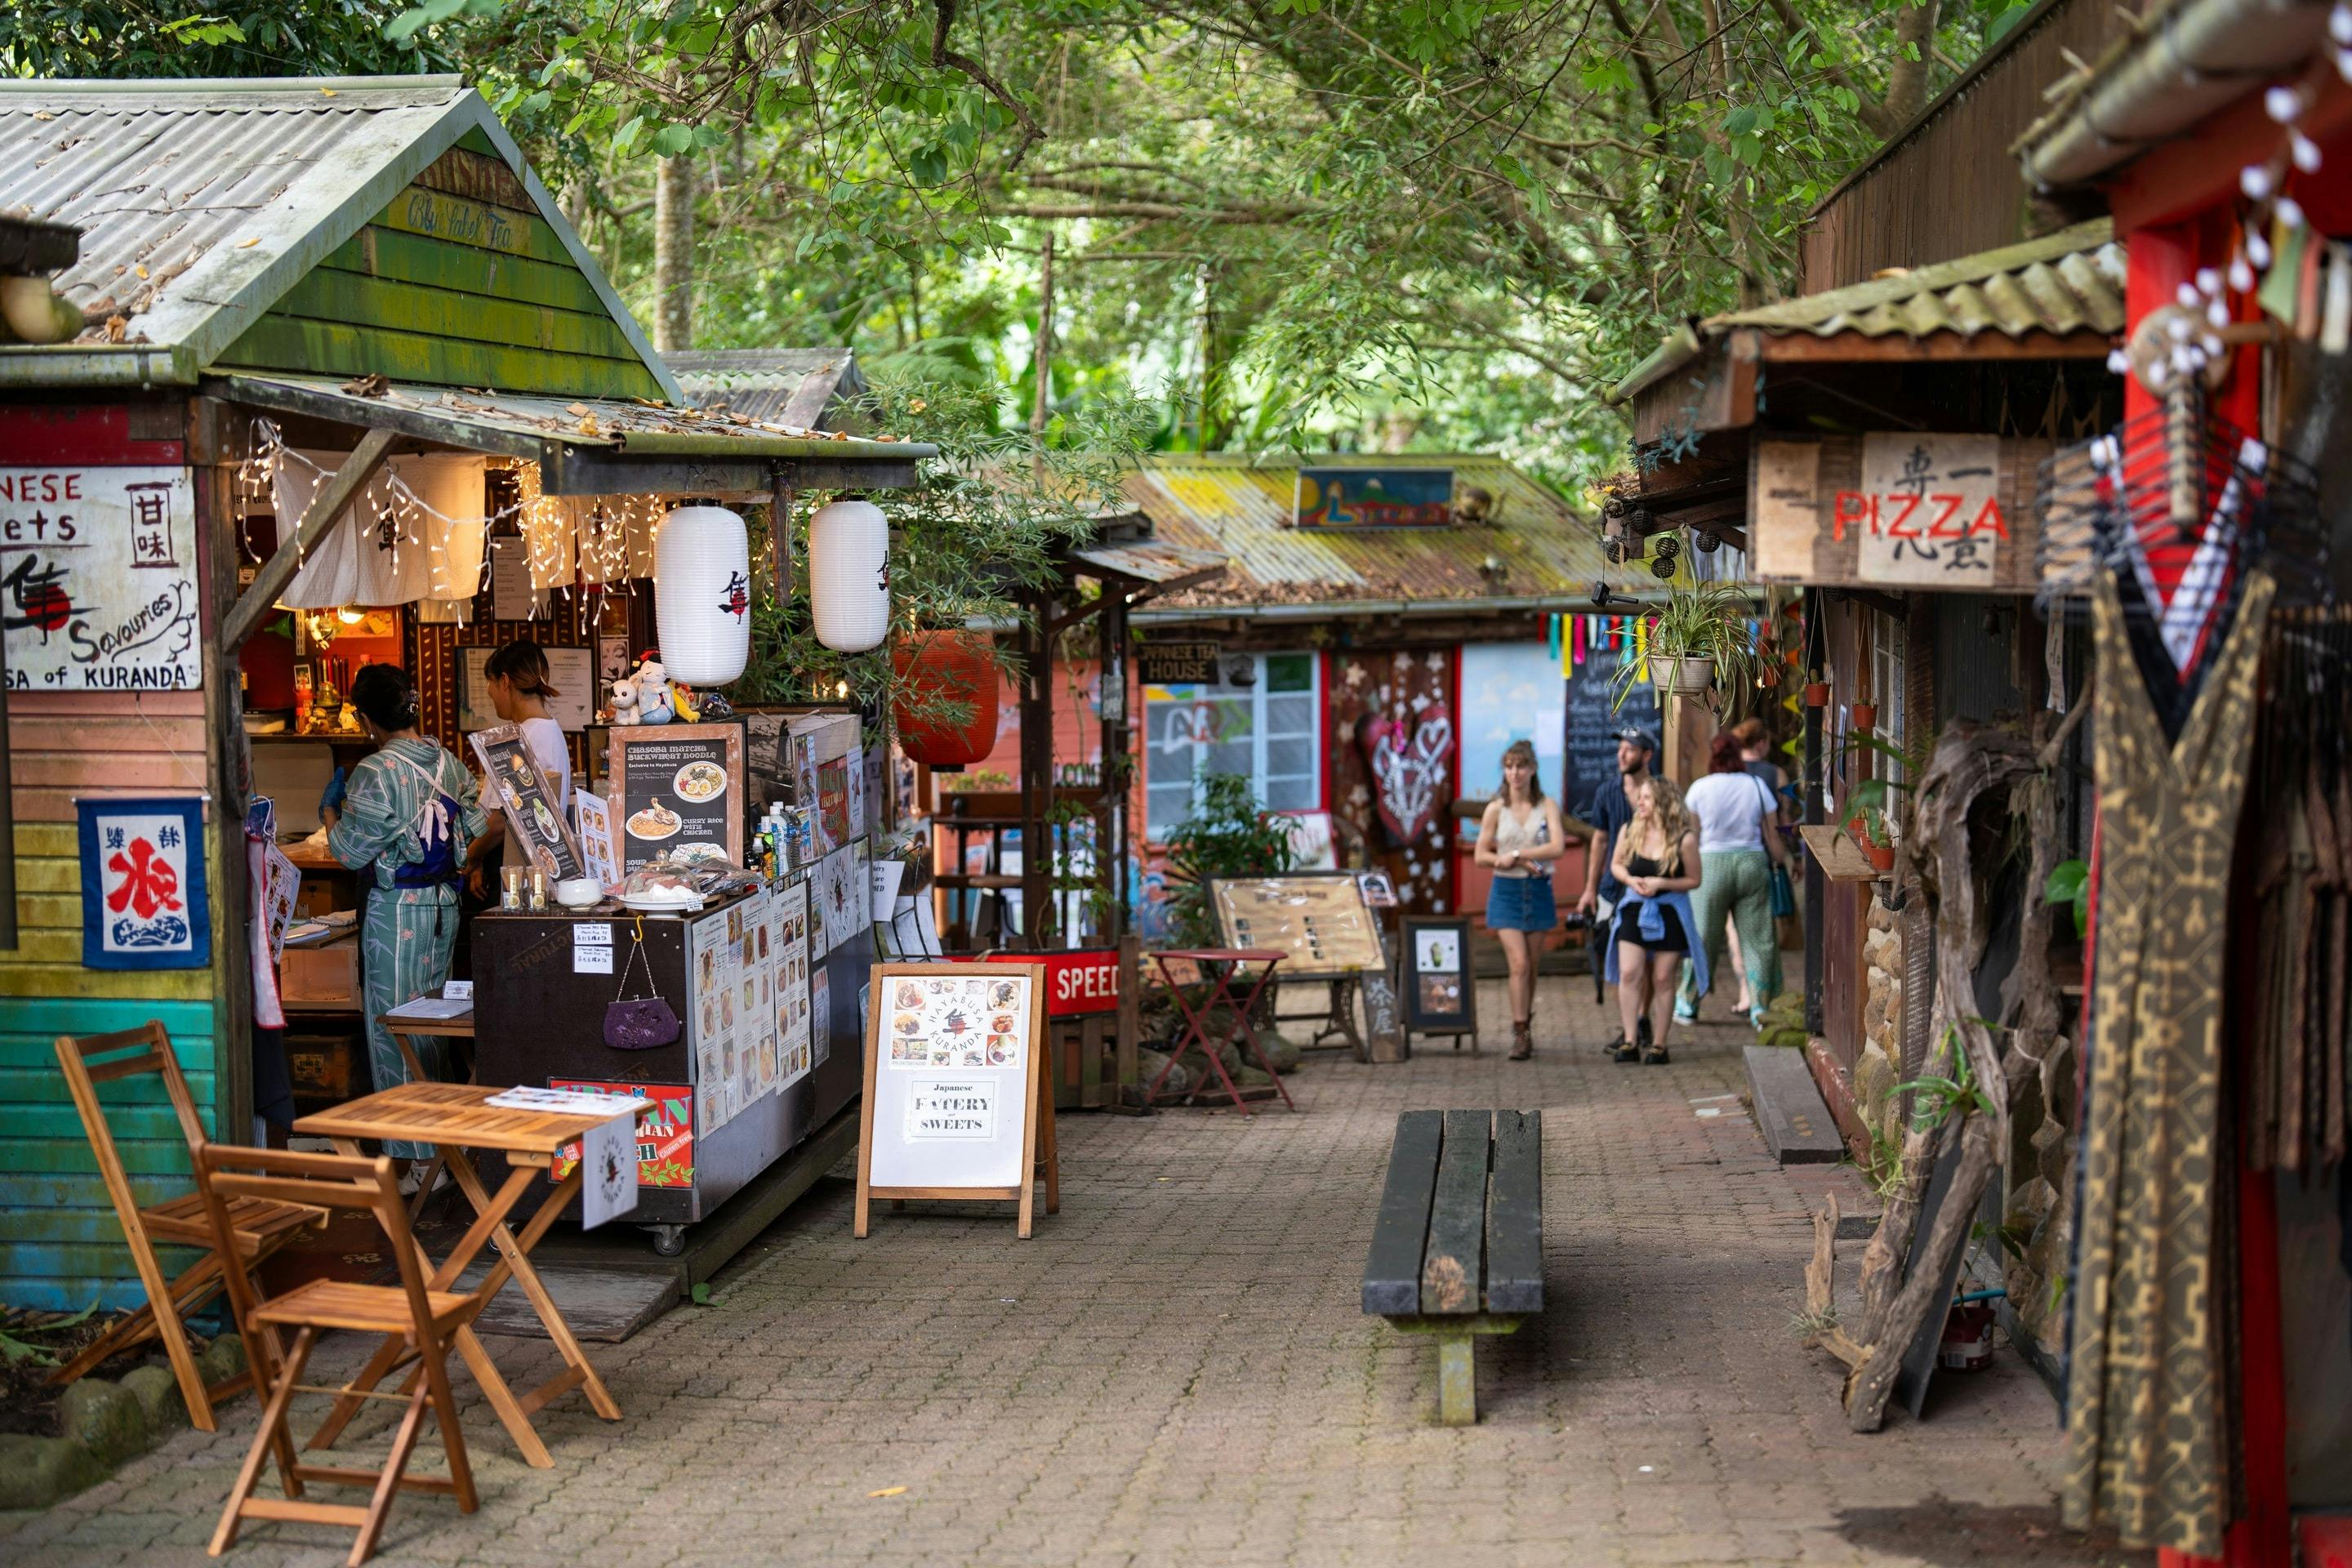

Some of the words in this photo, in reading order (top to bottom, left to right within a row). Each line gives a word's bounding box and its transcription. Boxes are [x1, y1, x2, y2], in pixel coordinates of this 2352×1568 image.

[135, 494, 167, 559] 甘味
[1833, 491, 2009, 541] PIZZA
[69, 593, 173, 665] Savouries
[44, 666, 68, 686] of
[85, 665, 187, 689] KURANDA
[1148, 661, 1209, 680] HOUSE
[929, 996, 984, 1023] HAYABUSA
[929, 1031, 982, 1052] KURANDA
[933, 1084, 973, 1093] Japanese
[920, 1119, 982, 1129] SWEETS
[659, 1142, 680, 1159] Gluten
